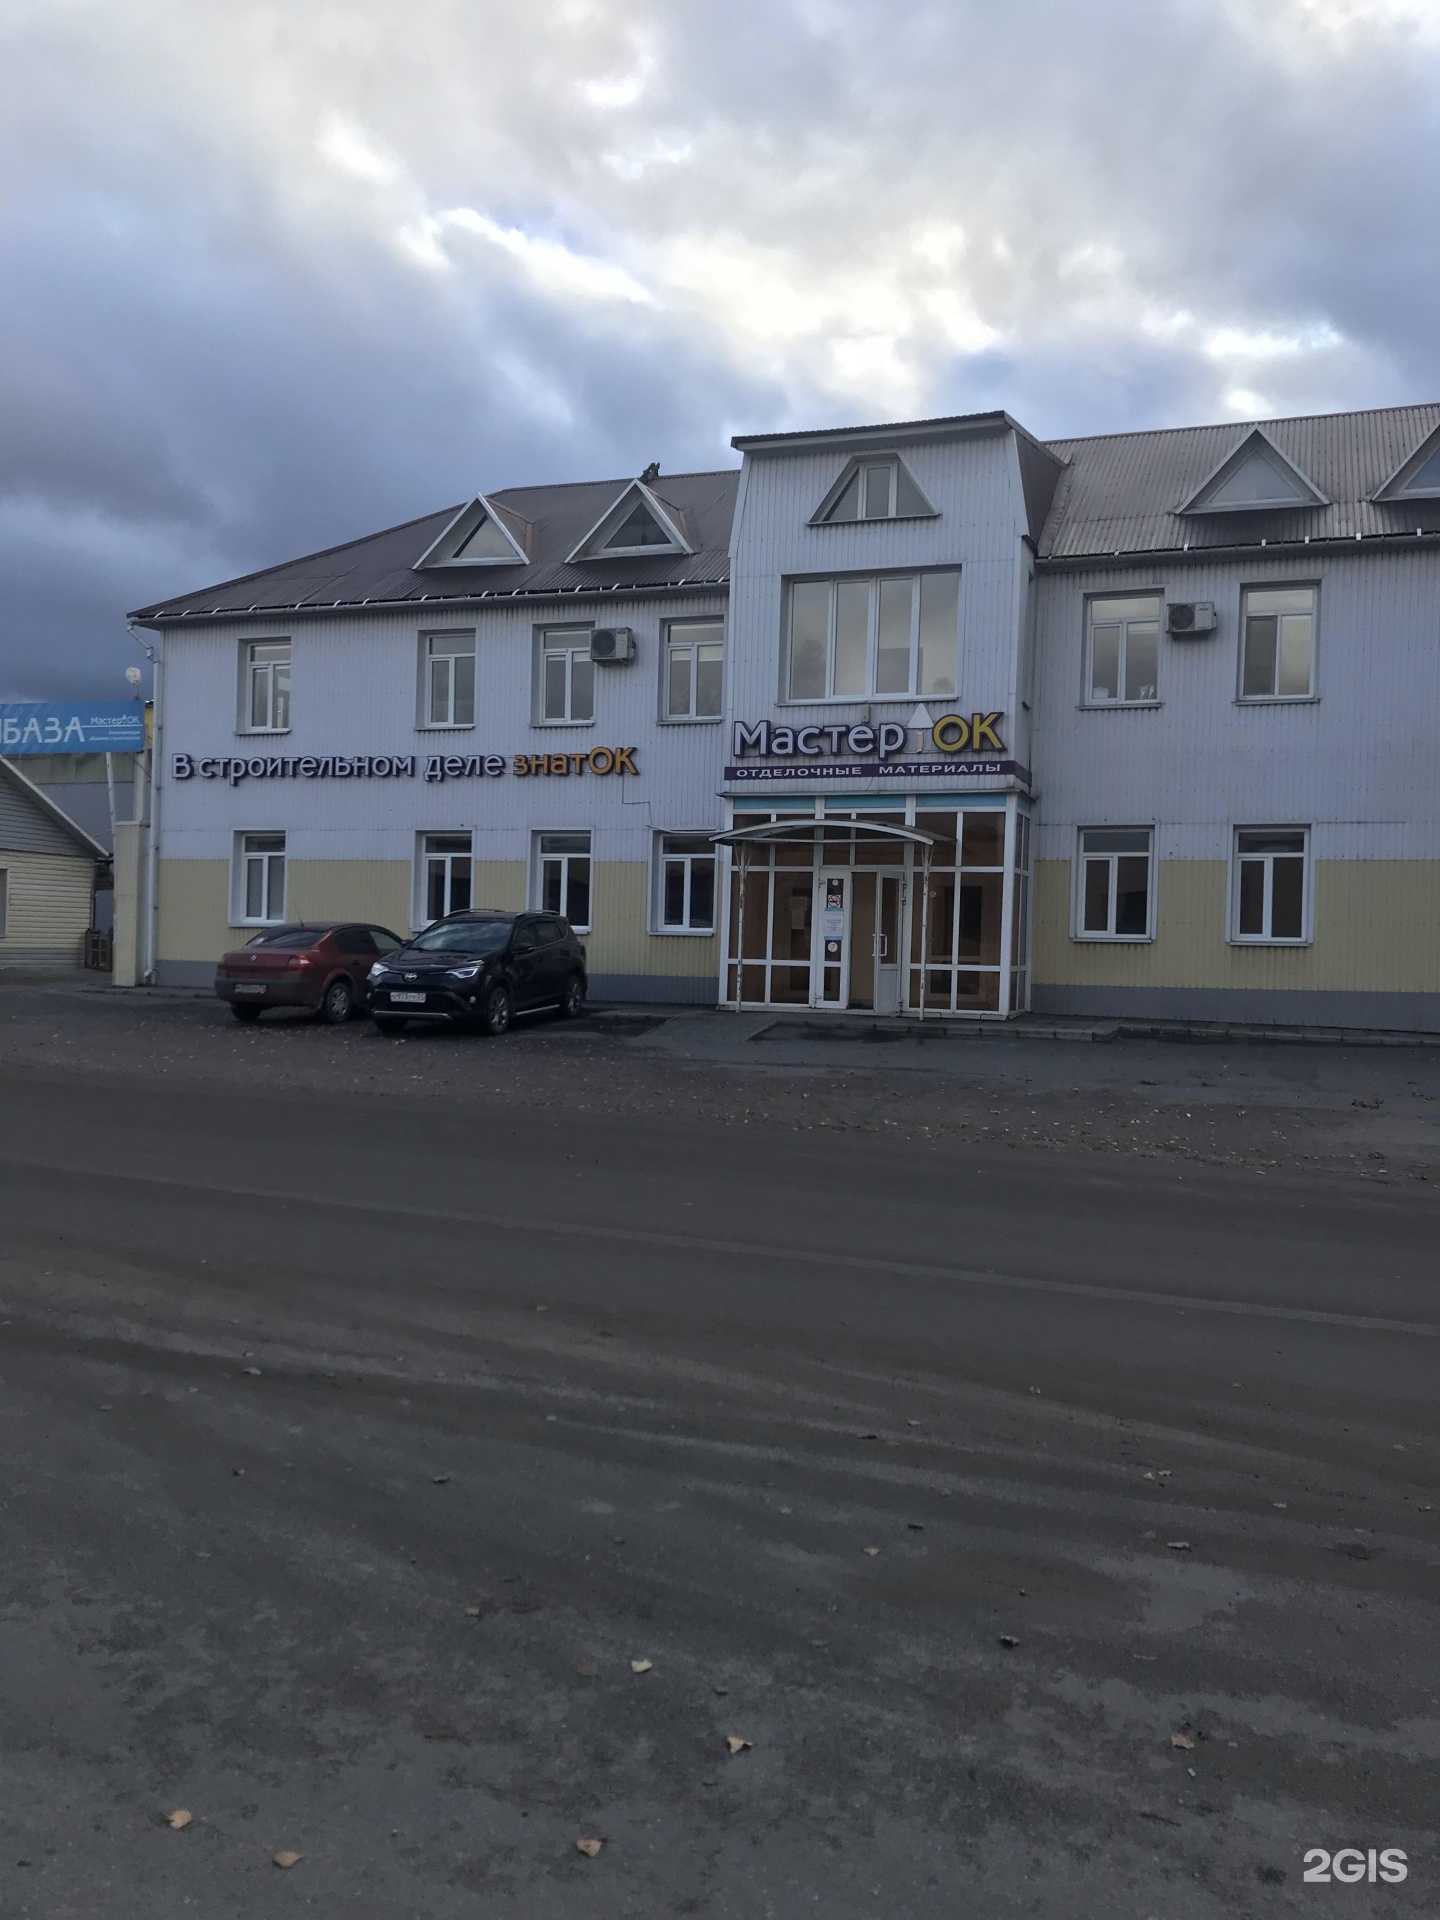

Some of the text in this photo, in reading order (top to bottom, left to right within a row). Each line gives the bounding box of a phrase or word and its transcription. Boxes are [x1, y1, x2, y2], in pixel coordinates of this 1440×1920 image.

[0, 717, 85, 744] БАЗА
[172, 745, 640, 787] В строительном деле знатОК
[736, 763, 1001, 778] ОТДЕЛОЧНЫЕ МАТЕРИАЛЫ
